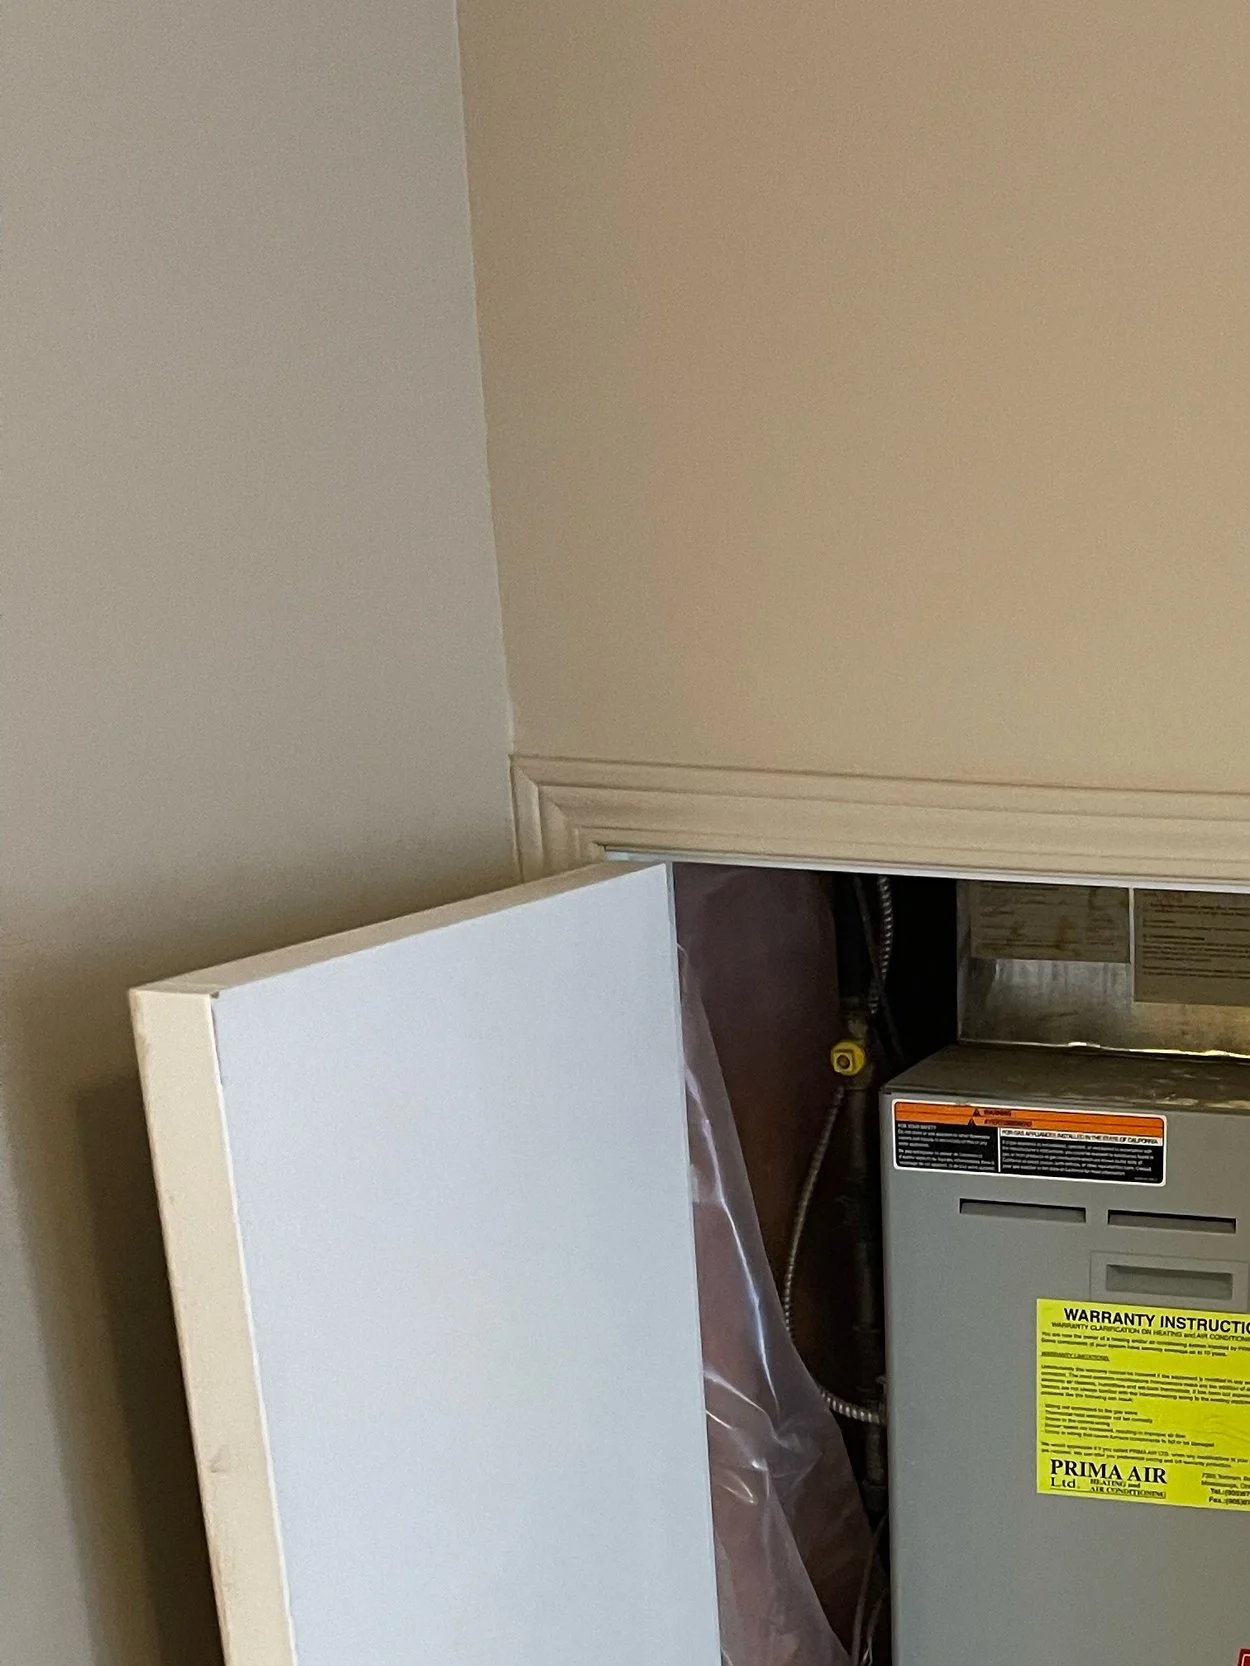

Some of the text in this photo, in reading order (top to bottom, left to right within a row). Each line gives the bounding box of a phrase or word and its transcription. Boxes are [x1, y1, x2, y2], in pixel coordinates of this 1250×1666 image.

[1064, 1308, 1155, 1327] WARRANTY
[1051, 1321, 1087, 1330] WARRANTY
[1090, 1324, 1139, 1334] CLARIFICATION
[1153, 1329, 1181, 1337] HEATING
[1050, 1459, 1166, 1483] PRIMA AIR
[1050, 1476, 1079, 1488] Ltd.
[1090, 1478, 1125, 1487] HEATING
[1106, 1487, 1164, 1497] CONDITIONING
